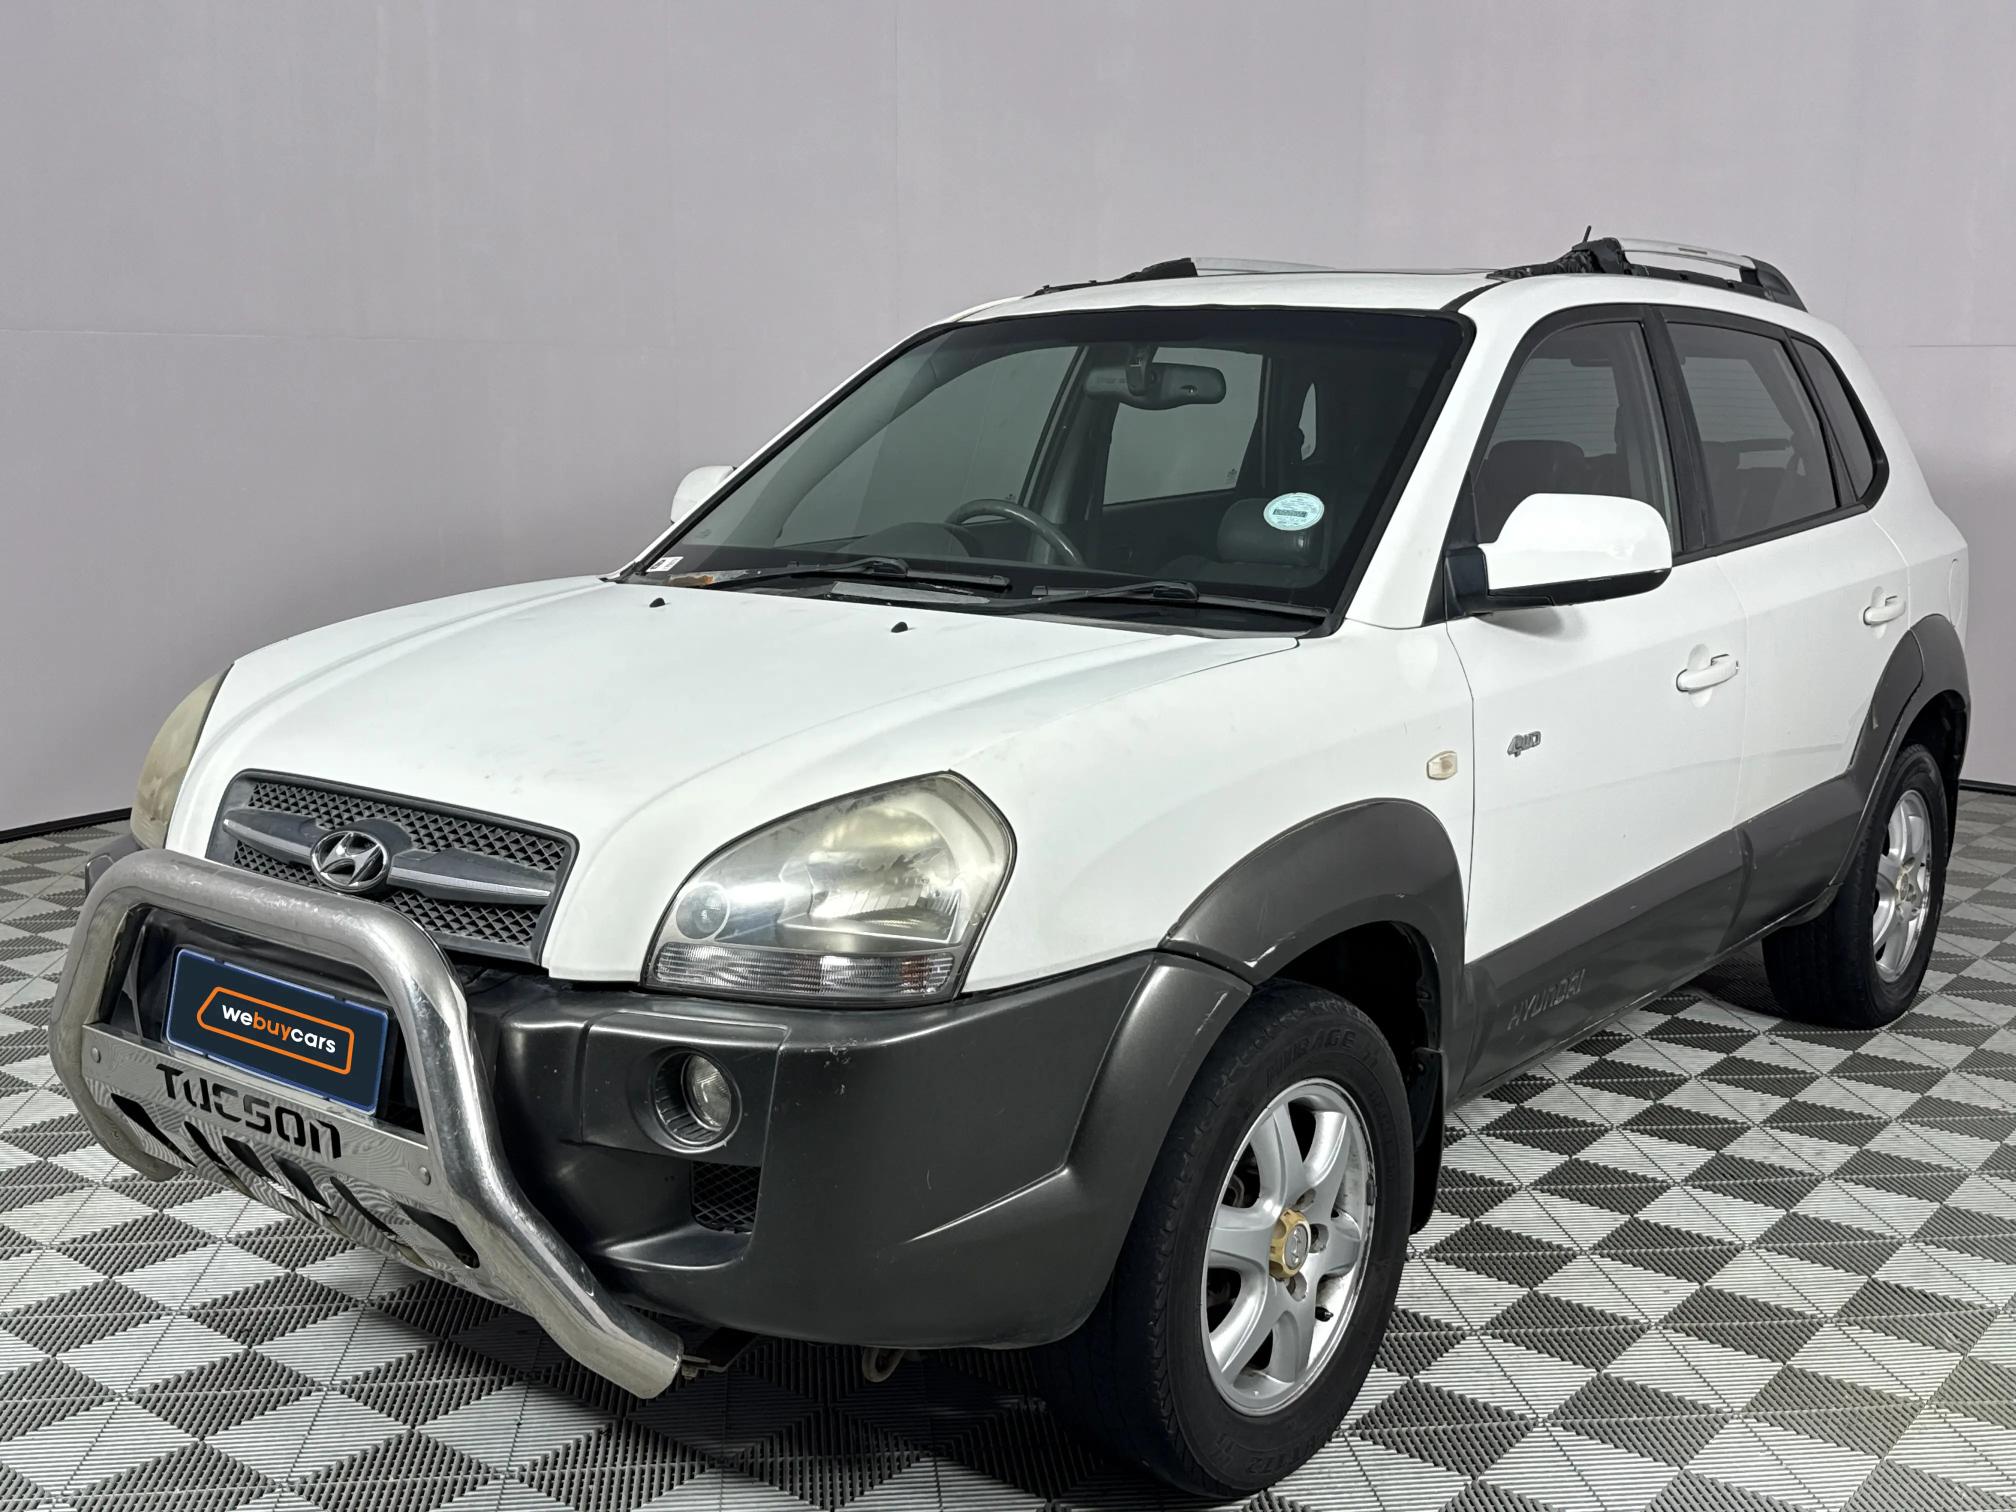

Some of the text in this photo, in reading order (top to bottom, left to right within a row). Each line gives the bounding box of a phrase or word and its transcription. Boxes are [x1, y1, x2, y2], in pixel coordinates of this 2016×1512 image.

[1507, 731, 1541, 757] 4WD
[1506, 967, 1586, 1031] HYUNDAI
[156, 1063, 342, 1160] TUCSON
